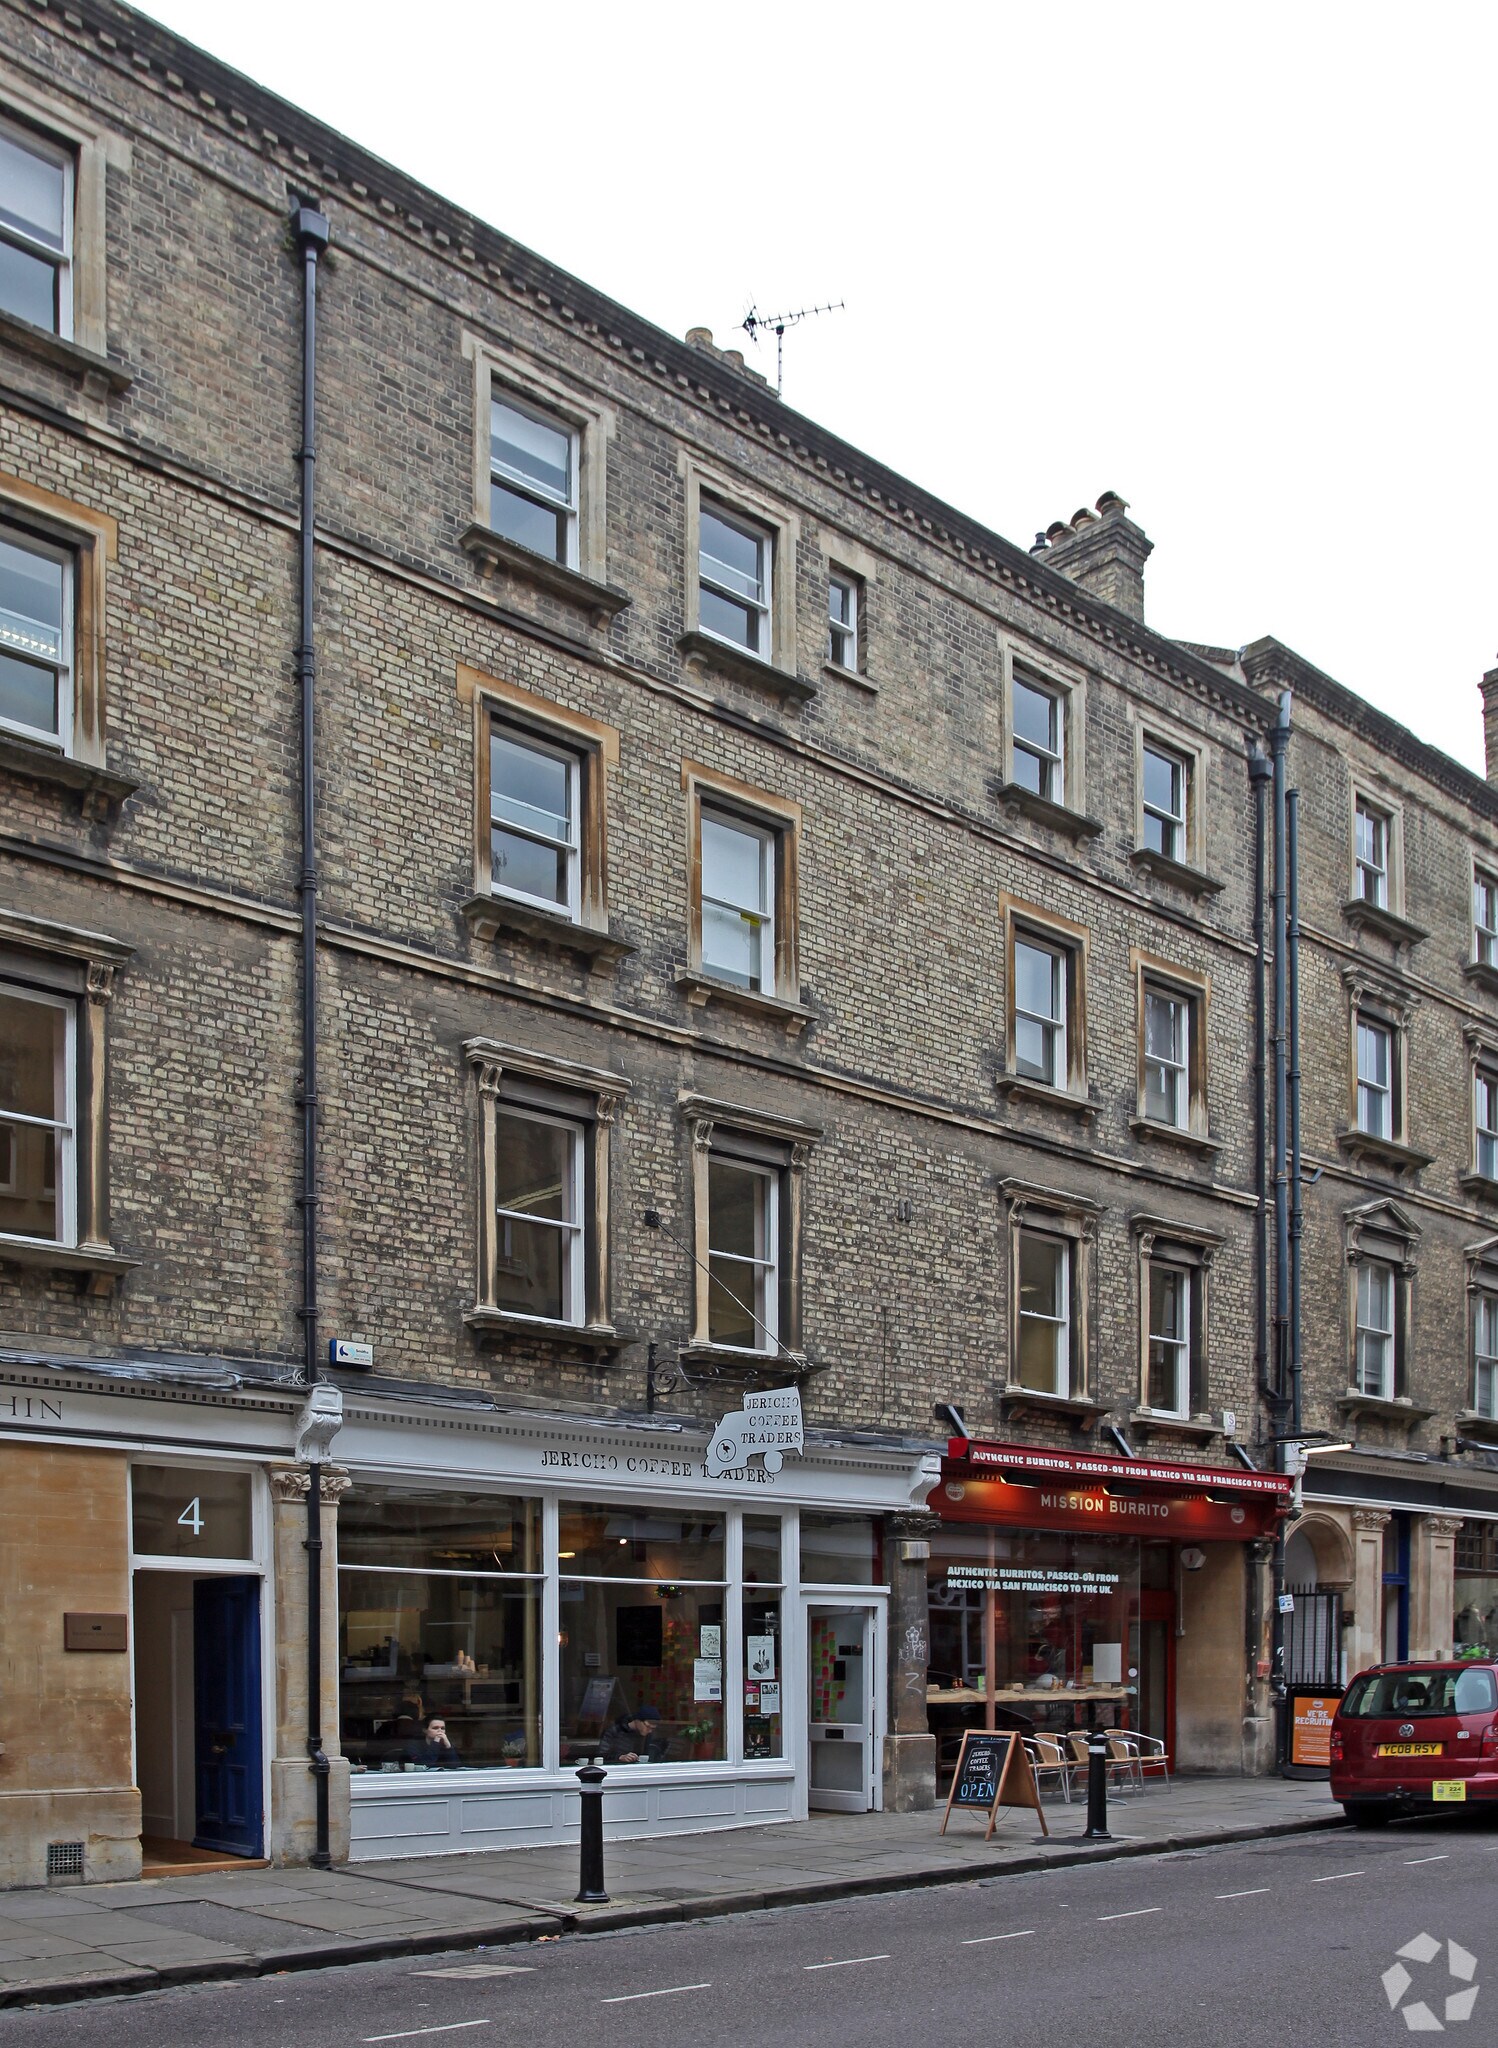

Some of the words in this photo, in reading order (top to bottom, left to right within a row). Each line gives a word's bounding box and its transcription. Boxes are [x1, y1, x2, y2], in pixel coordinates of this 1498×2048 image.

[746, 1396, 799, 1410] JERICHO
[749, 1414, 798, 1427] COFFEE
[741, 1431, 801, 1444] TRADERS
[541, 1450, 618, 1471] JERICHO
[626, 1457, 692, 1477] COFFEE
[700, 1463, 776, 1484] TADERS
[972, 1451, 1024, 1465] AUTHENTIC
[1026, 1457, 1073, 1470] BURRITOS,
[1076, 1461, 1124, 1474] PASSED-ON
[1125, 1466, 1148, 1477] FROM
[1150, 1469, 1180, 1480] MEXICO
[1181, 1472, 1195, 1481] VIA
[1196, 1473, 1211, 1483] SAN
[1213, 1476, 1251, 1487] FRANCISCO
[1253, 1479, 1262, 1489] TO
[1263, 1481, 1277, 1490] THE
[1041, 1494, 1104, 1512] MISSION
[1109, 1500, 1169, 1517] BURRITO
[178, 1497, 205, 1535] 4
[947, 1566, 998, 1577] AUTHENTIC
[1000, 1568, 1045, 1580] BURRITOS,
[1047, 1571, 1094, 1582] PASSED-ON
[1096, 1573, 1119, 1583] FROM
[947, 1578, 984, 1589] MEXICO
[985, 1580, 1001, 1590] VIA
[1002, 1581, 1021, 1591] SAN
[1022, 1582, 1069, 1593] FRANCISCO
[1070, 1584, 1081, 1593] TO
[1082, 1584, 1098, 1594] THE
[1099, 1585, 1113, 1594] UK.
[1384, 1744, 1411, 1754] YC08
[1414, 1744, 1437, 1753] RSY
[960, 1782, 995, 1798] OPEN
